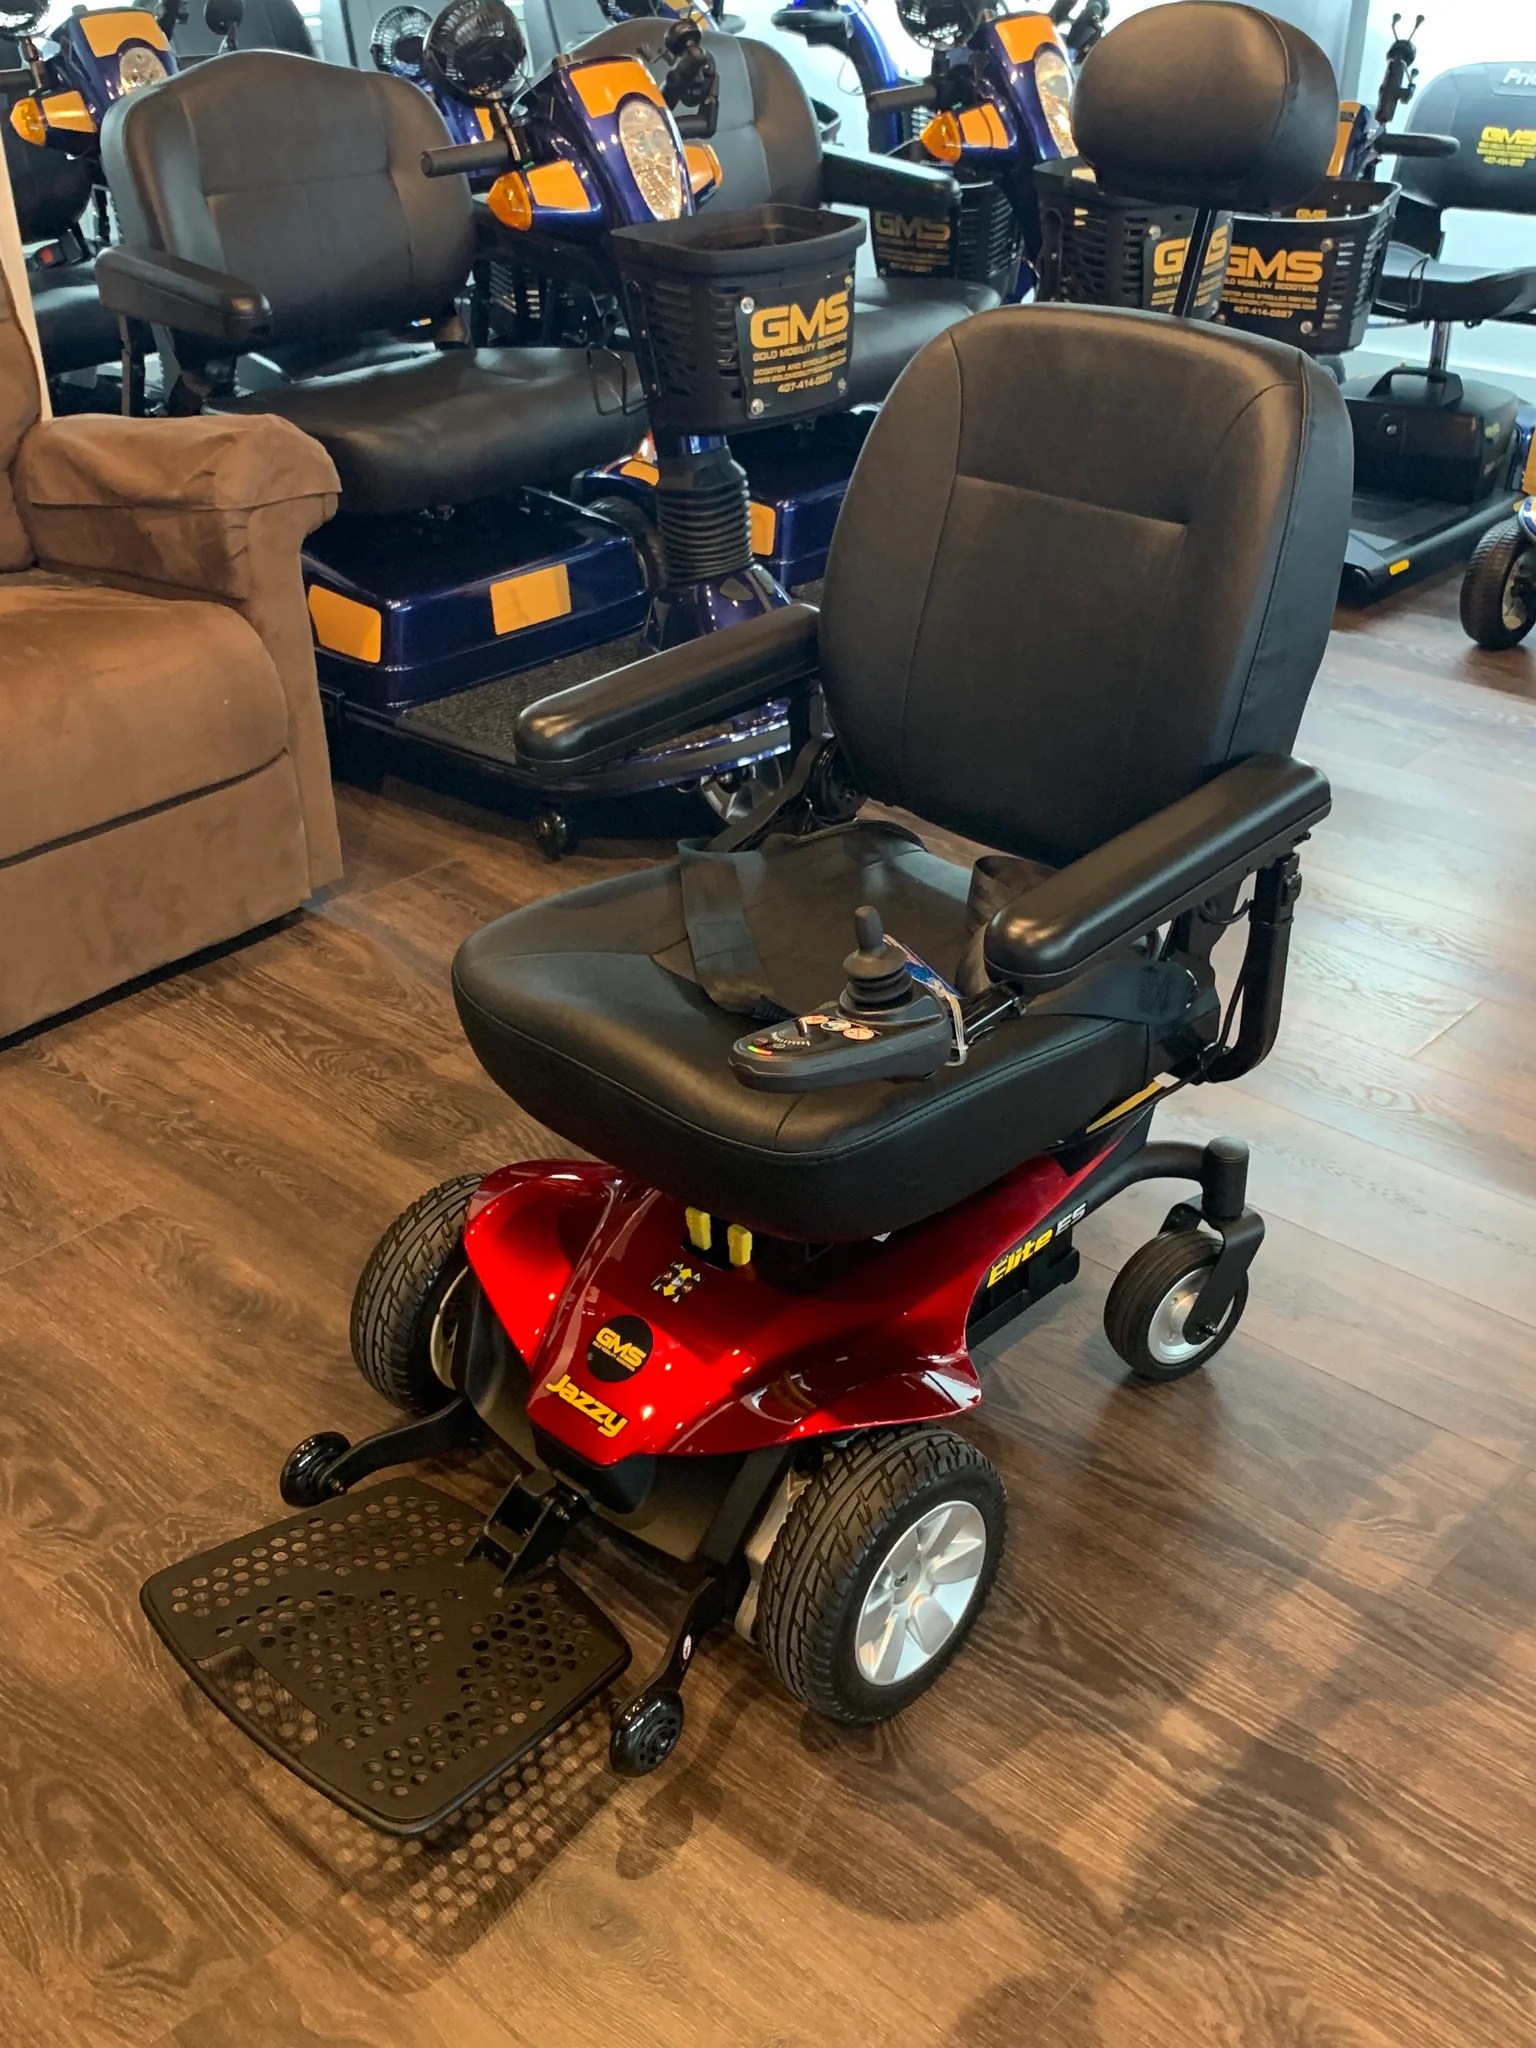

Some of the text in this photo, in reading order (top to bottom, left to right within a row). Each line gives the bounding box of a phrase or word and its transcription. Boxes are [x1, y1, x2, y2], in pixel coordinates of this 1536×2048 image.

[1481, 126, 1536, 145] GMS
[874, 210, 951, 241] GMS
[750, 291, 850, 349] GMS
[752, 350, 779, 362] GOLD
[779, 342, 817, 358] MOBILITY
[753, 365, 786, 377] SCOOTER
[986, 1201, 1088, 1289] Elite ES
[596, 1327, 647, 1368] GMS
[546, 1374, 628, 1438] Jazzy
